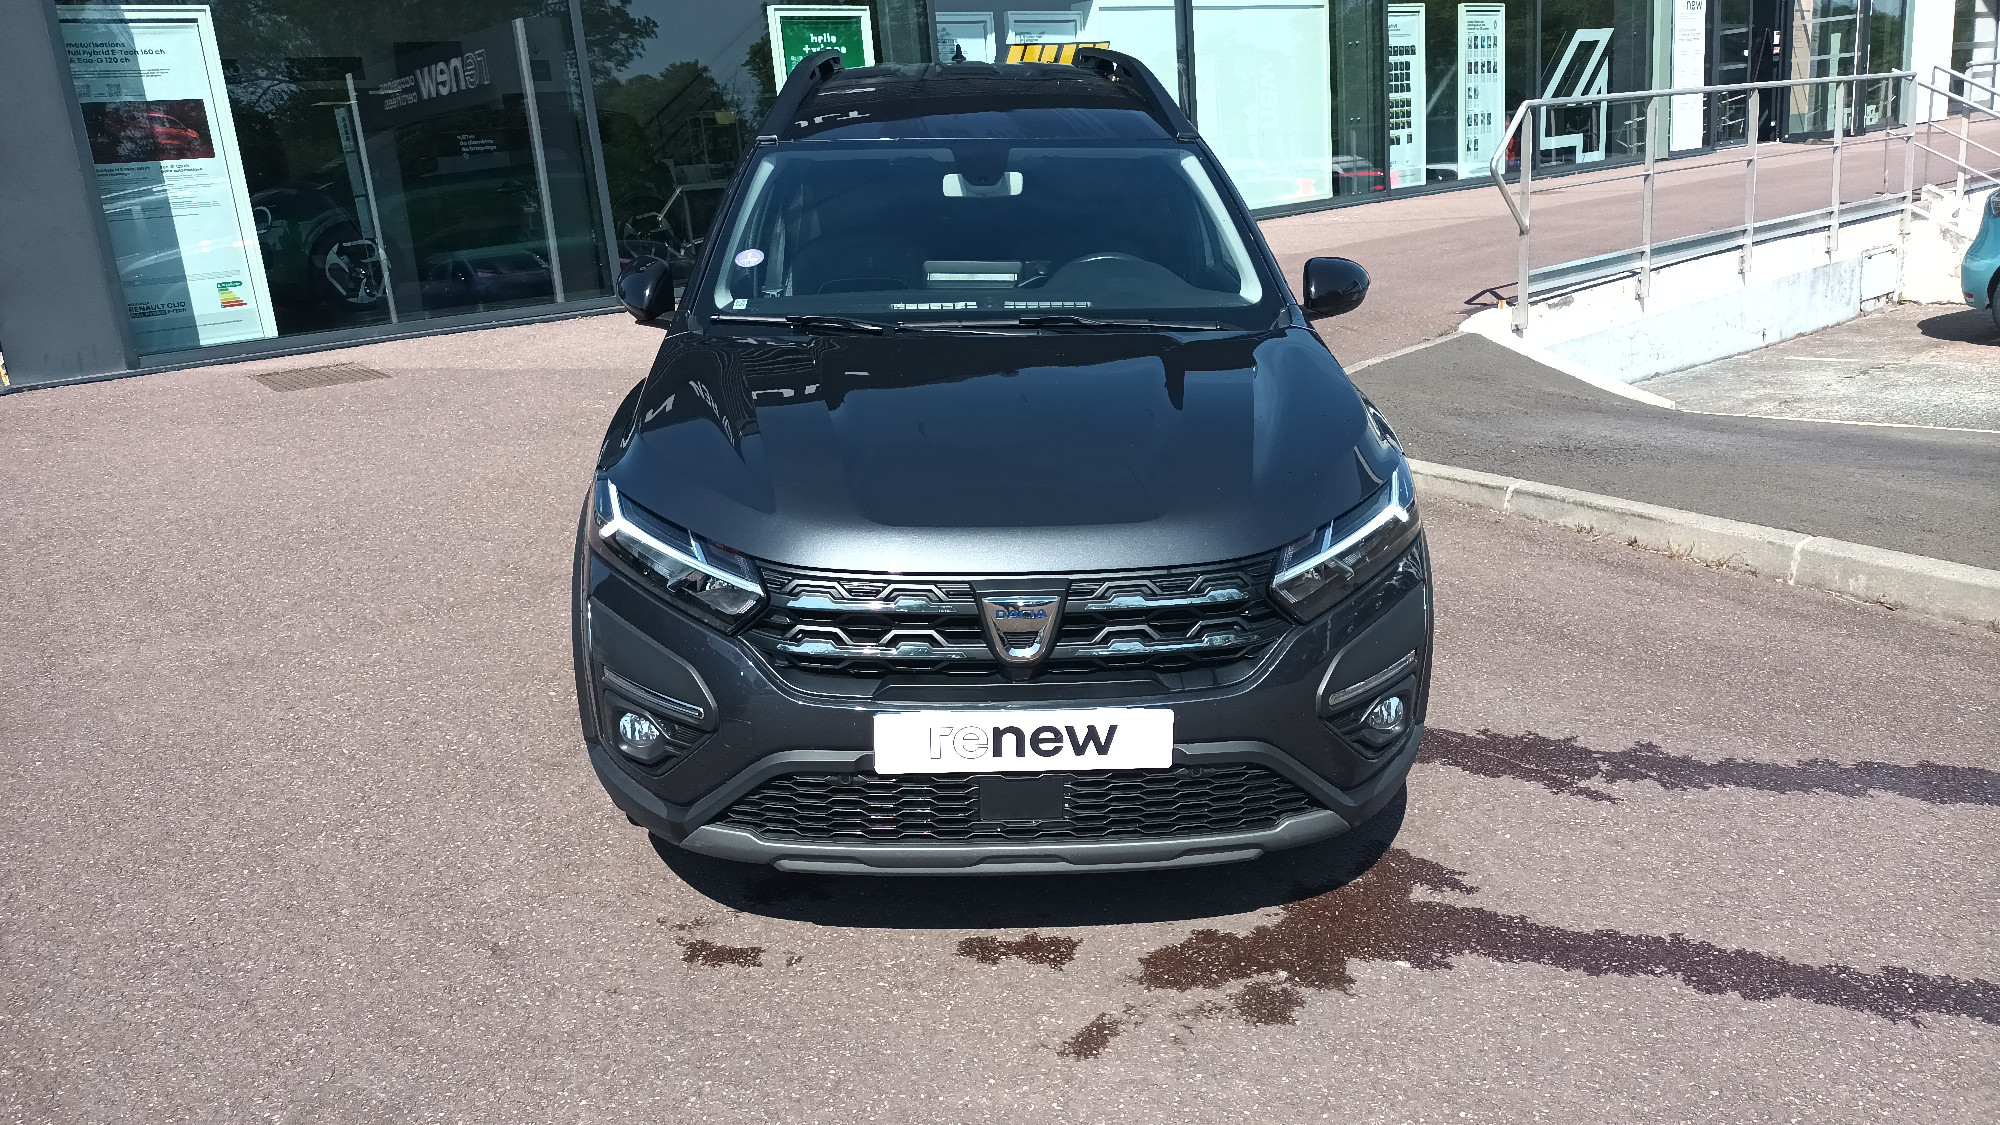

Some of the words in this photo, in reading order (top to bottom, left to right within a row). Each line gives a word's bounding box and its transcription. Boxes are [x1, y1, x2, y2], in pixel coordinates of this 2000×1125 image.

[809, 32, 837, 43] hello
[65, 41, 126, 49] motorisations
[82, 49, 110, 58] hybrid
[128, 303, 166, 313] RENAULT
[995, 609, 1048, 620] DACIA
[929, 723, 1119, 760] renew
